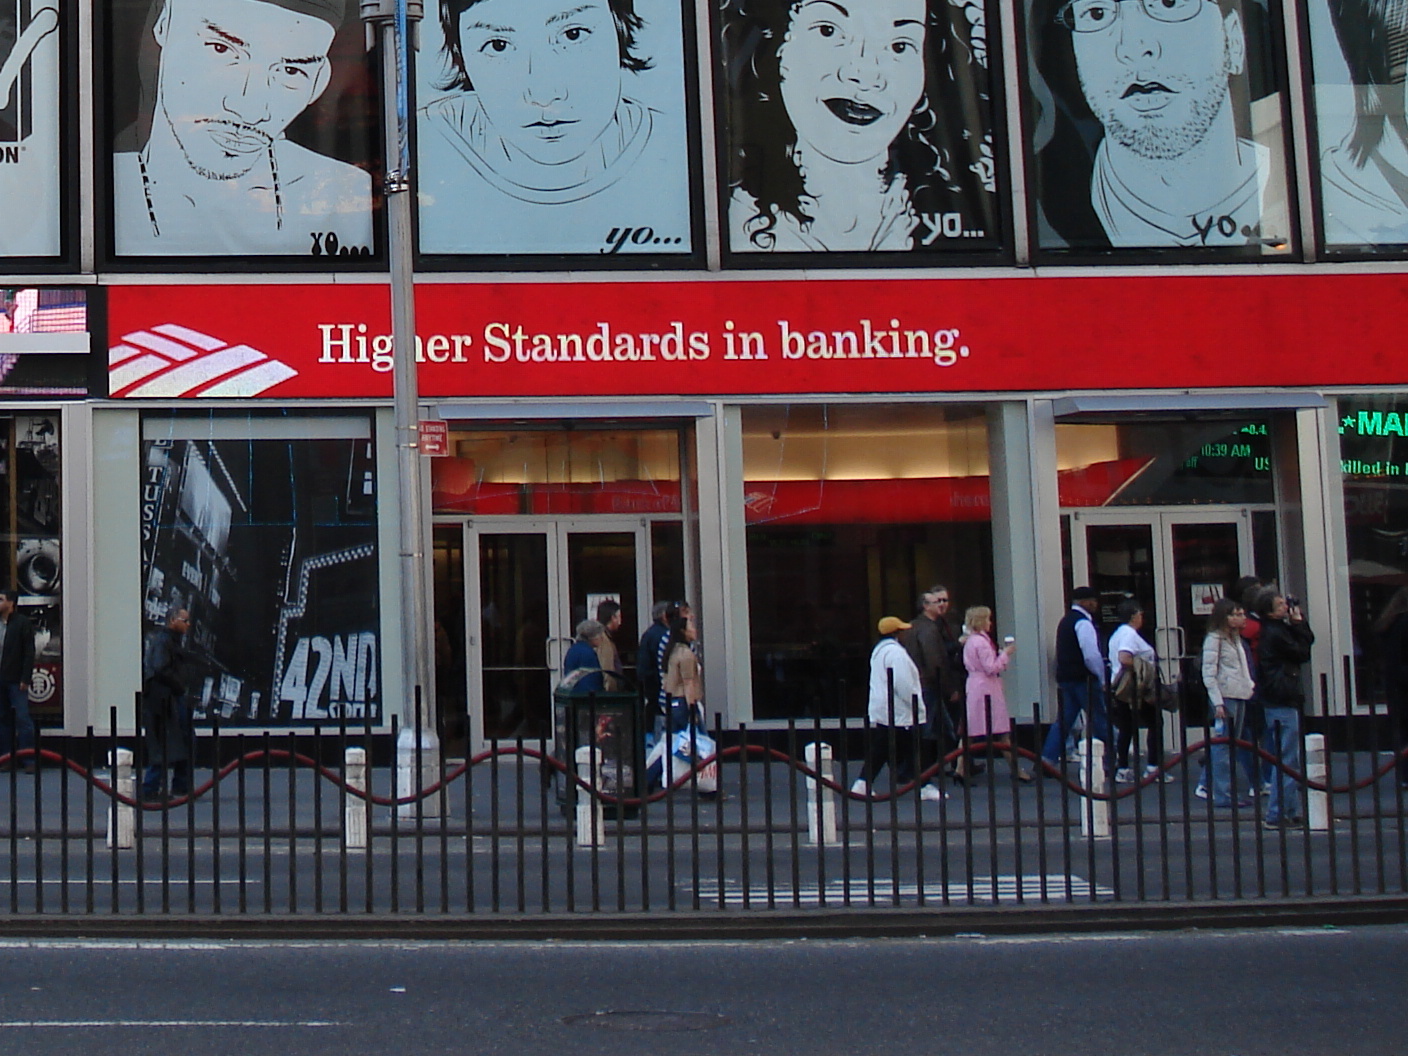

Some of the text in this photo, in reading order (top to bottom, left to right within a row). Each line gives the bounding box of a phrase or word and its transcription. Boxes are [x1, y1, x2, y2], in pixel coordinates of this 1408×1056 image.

[318, 318, 971, 372] Higer Standards in banking.
[280, 631, 378, 719] 42ND
